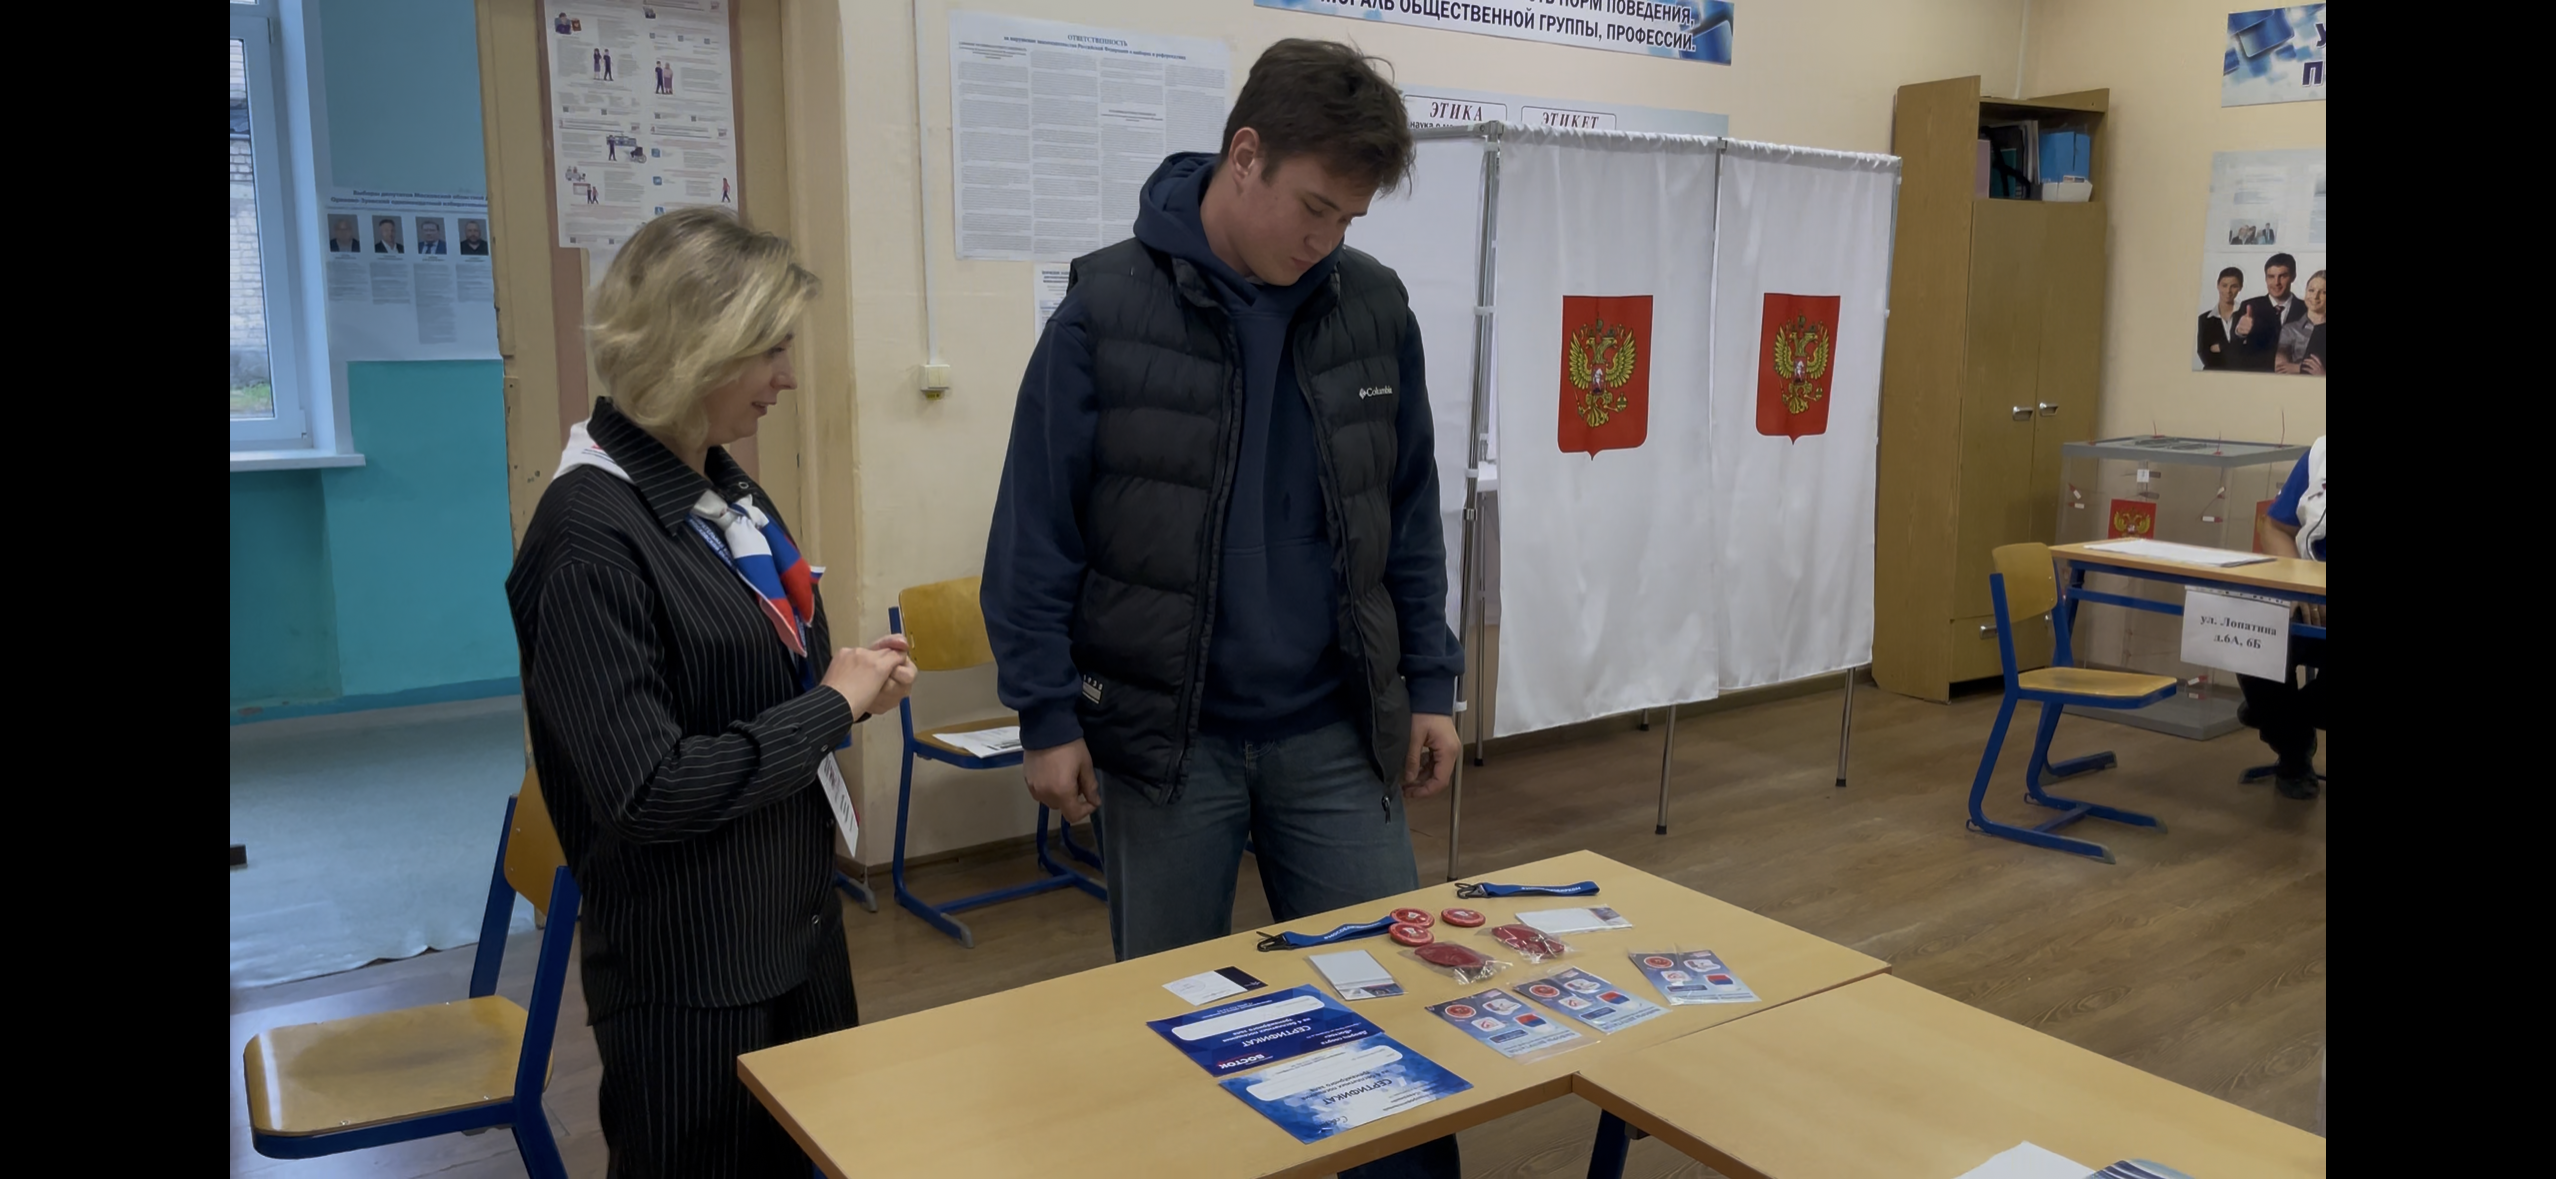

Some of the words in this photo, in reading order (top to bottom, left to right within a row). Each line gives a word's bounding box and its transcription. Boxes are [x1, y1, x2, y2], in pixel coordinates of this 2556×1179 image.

[1606, 0, 1695, 27] ПОВЕДЕНИЯ,
[1400, 0, 1535, 30] ОБЩЕСТВЕННОЙ
[1540, 14, 1602, 41] ГРУППЫ,
[1607, 24, 1695, 50] ПРОФЕССИИ.
[1429, 102, 1483, 121] ЭТИКА
[1541, 111, 1599, 129] ЭТИКЕТ
[2200, 615, 2217, 625] ул.
[2220, 617, 2276, 636] Лопатина
[2246, 637, 2261, 649] 6Б
[1242, 1025, 1311, 1047] СЕРТИФИКАТ
[1322, 1078, 1393, 1105] СЕРТИФИКАТ
